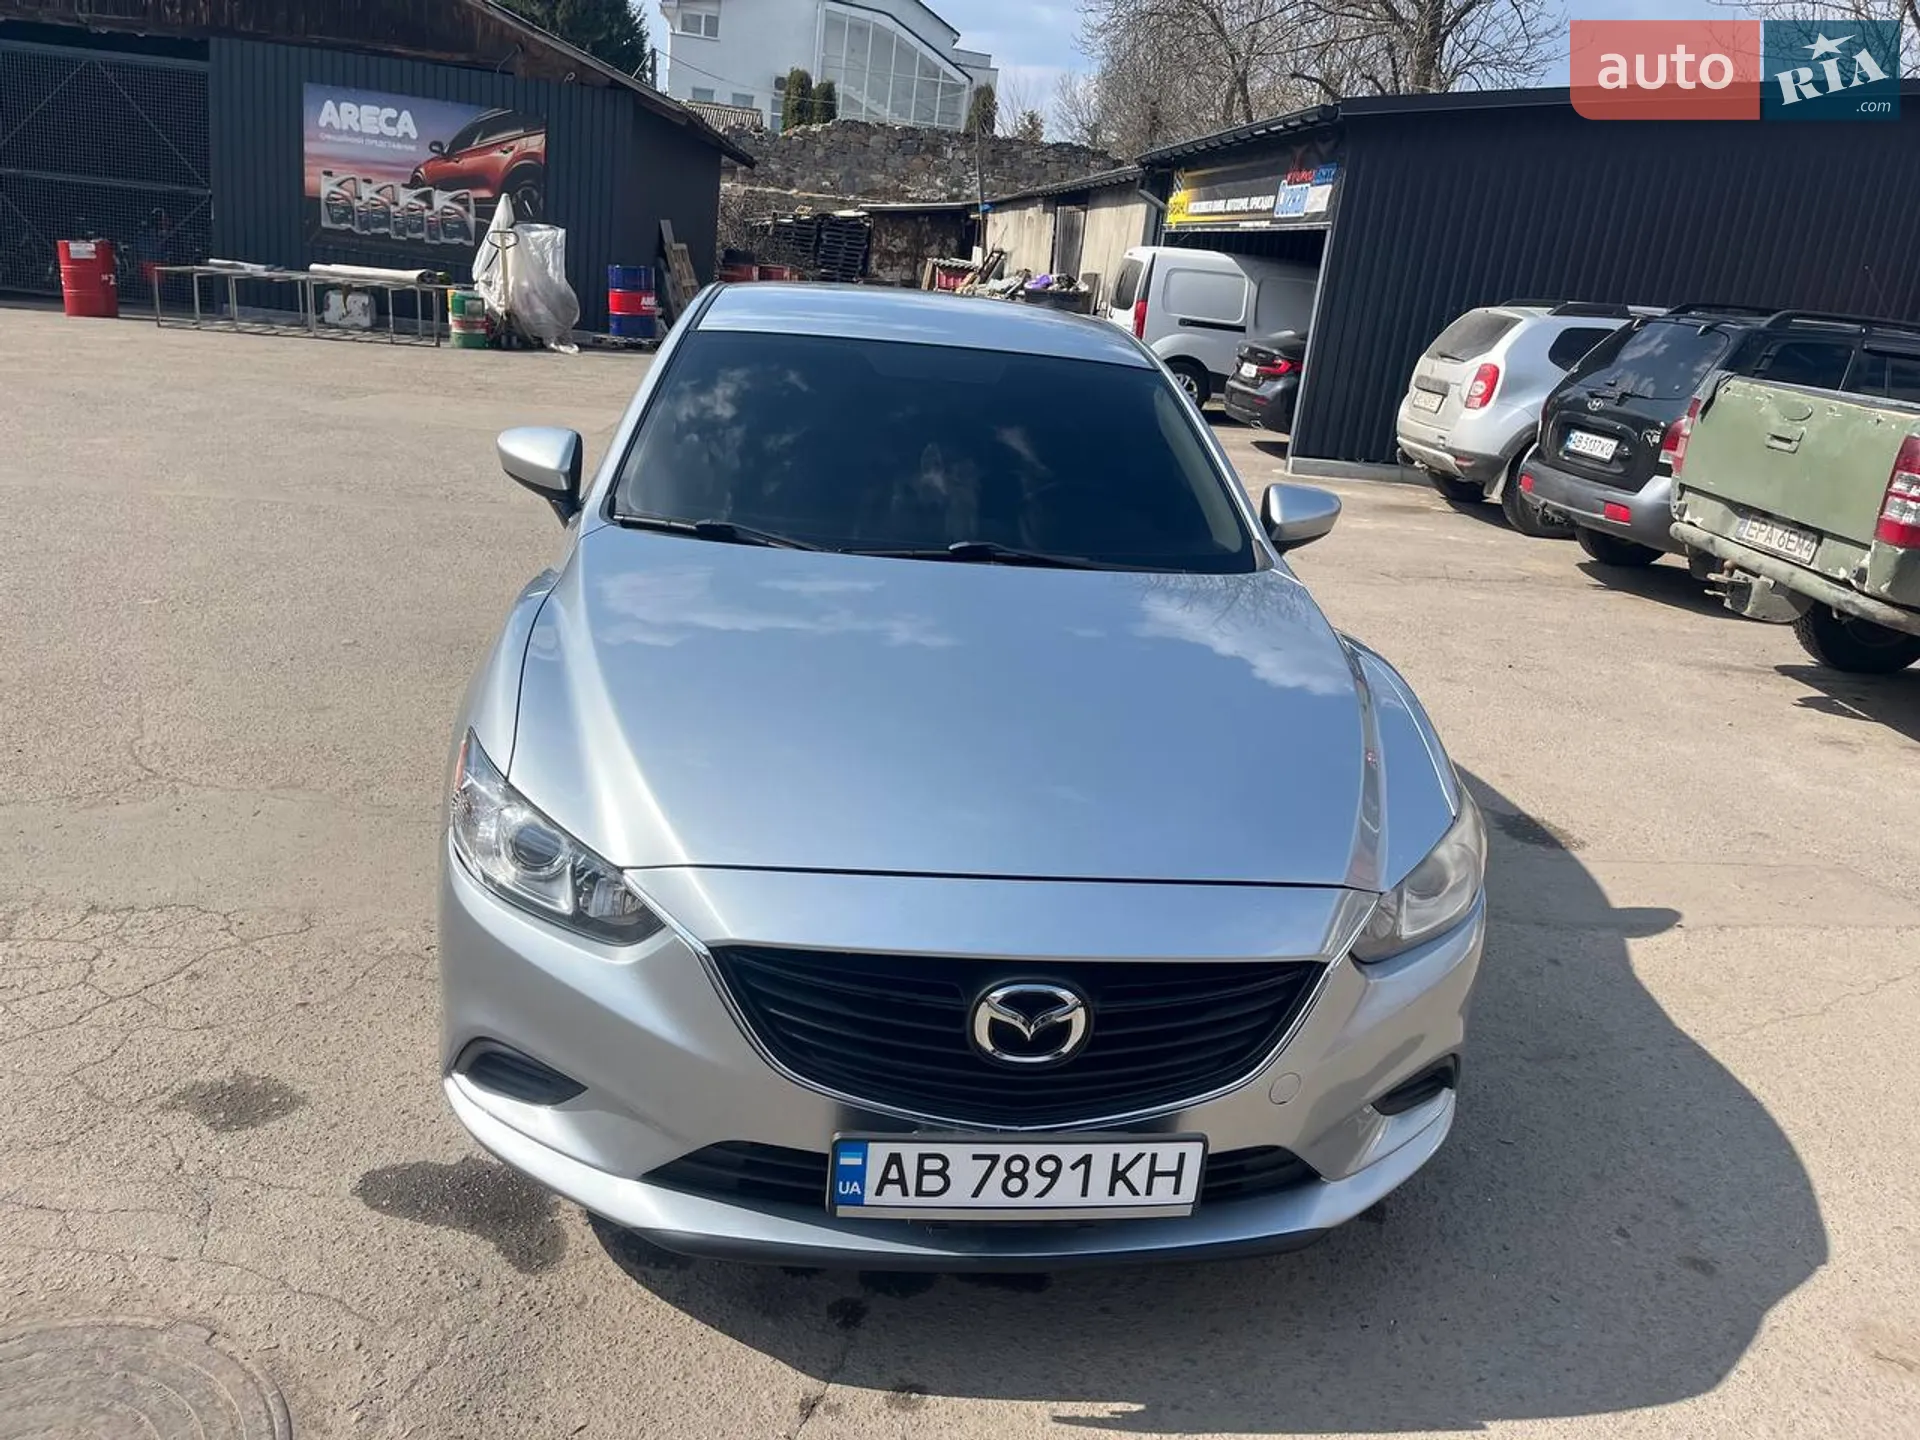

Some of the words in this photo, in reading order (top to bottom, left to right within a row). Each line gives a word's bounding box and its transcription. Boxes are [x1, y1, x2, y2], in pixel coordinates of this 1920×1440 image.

[318, 99, 418, 140] ARECA
[838, 1182, 861, 1195] UA
[874, 1151, 951, 1199] AB
[970, 1152, 1094, 1199] 7891
[1107, 1151, 1187, 1198] KH
